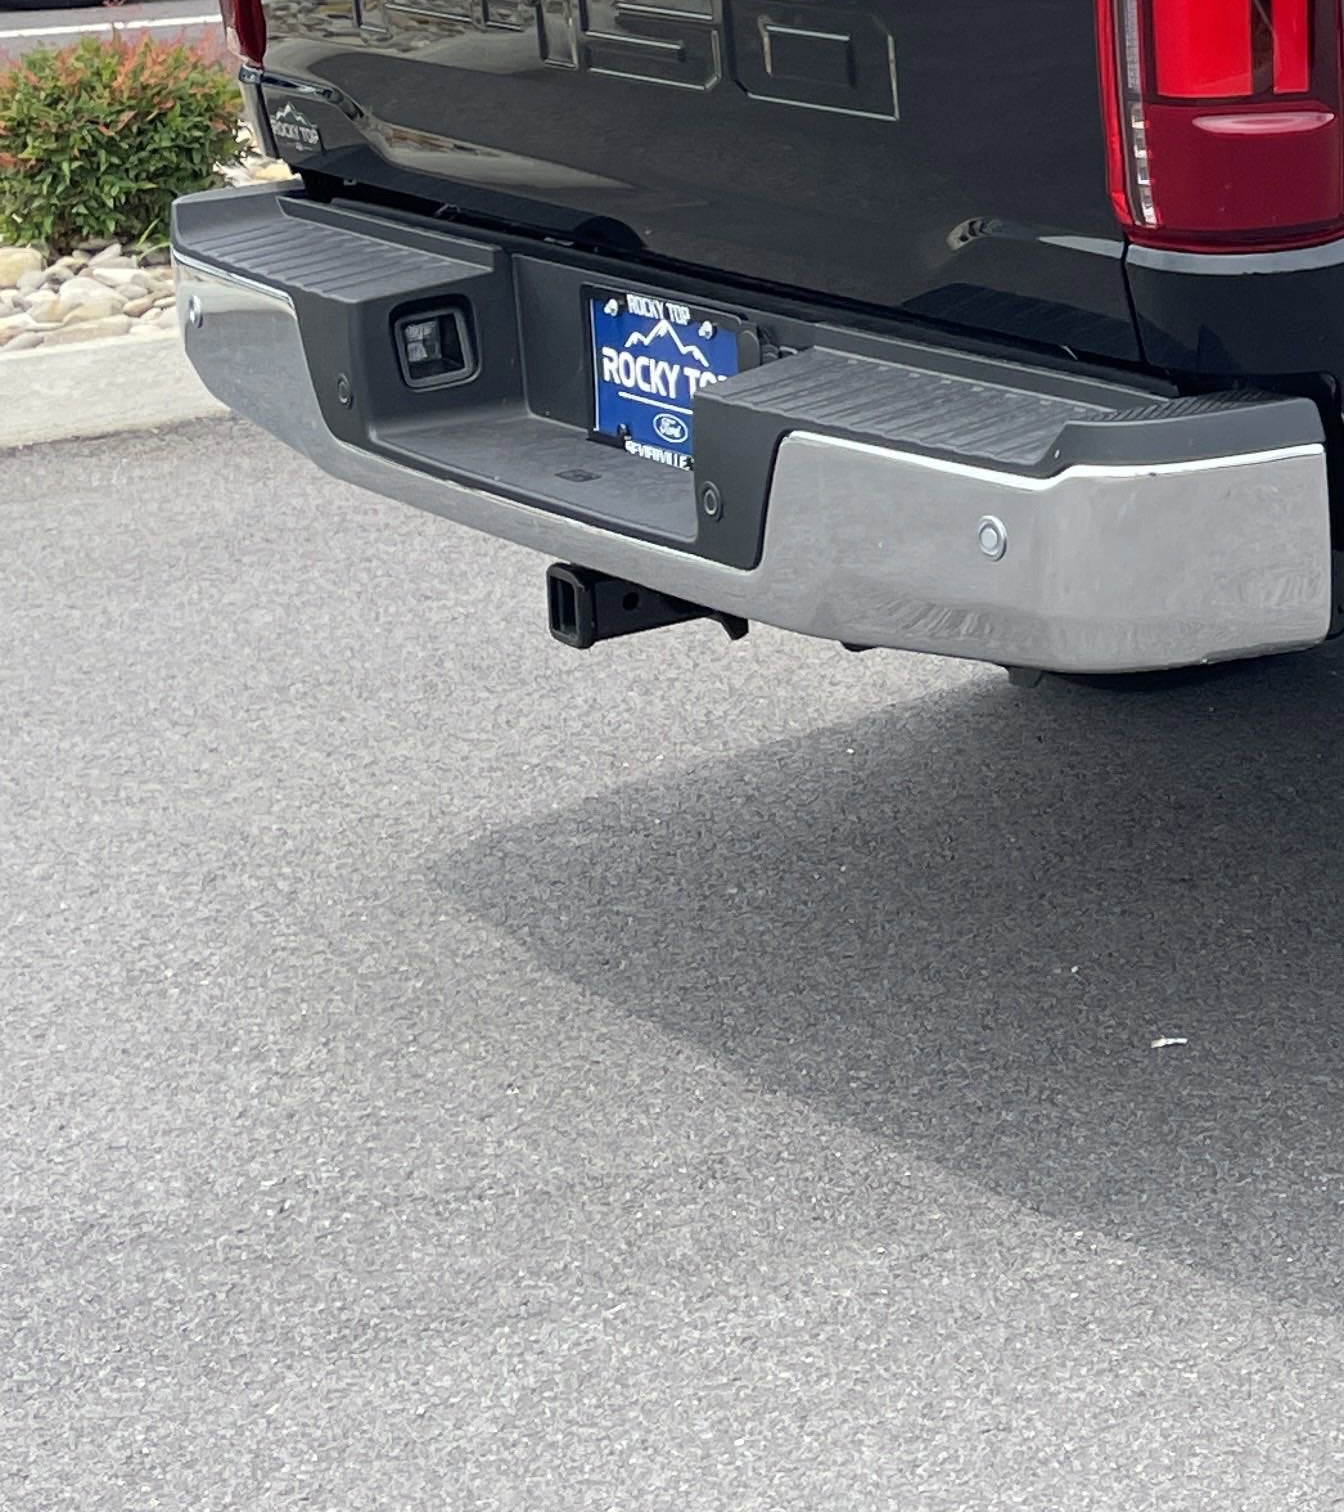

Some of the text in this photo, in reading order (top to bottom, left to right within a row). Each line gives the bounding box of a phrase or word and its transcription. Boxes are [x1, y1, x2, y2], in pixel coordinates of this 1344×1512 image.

[626, 293, 691, 326] ROCKY TOP
[602, 346, 681, 399] ROCKY
